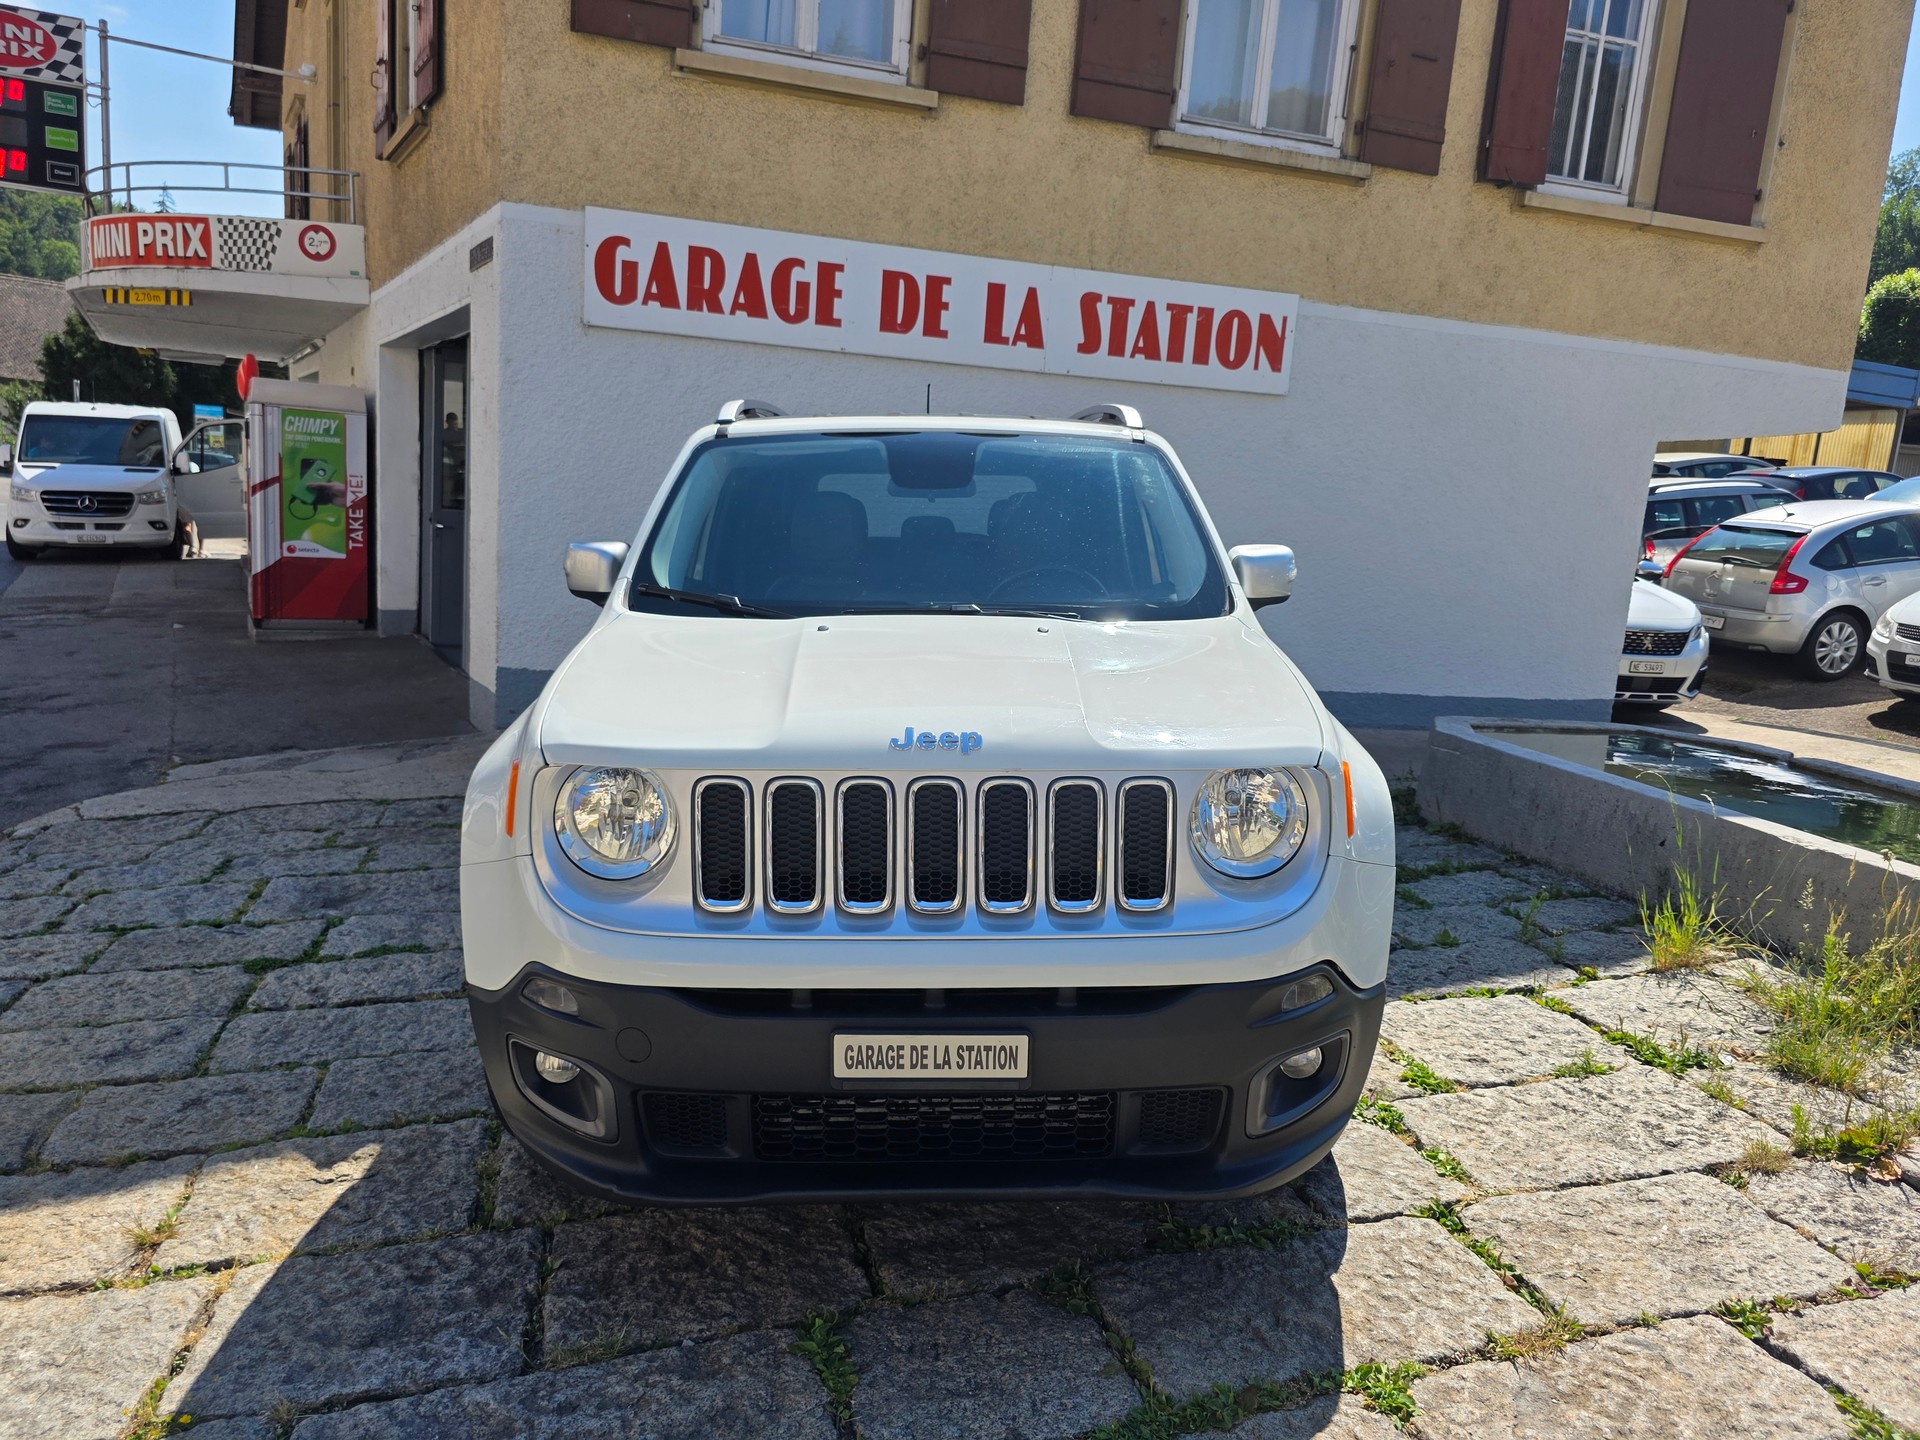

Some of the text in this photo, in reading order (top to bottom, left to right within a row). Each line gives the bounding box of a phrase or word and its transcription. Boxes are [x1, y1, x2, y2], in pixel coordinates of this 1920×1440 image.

[4, 23, 44, 45] NI
[0, 39, 46, 61] RIX
[93, 221, 208, 259] MINI PRIX
[594, 235, 1289, 374] GARAGE DE LA STATION
[284, 415, 339, 435] CHIMPY
[349, 474, 364, 550] TAKE ME!
[1633, 663, 1663, 672] NE 53493
[889, 727, 983, 754] Jeep
[844, 1044, 1019, 1070] GARAGE DE LA STATION
